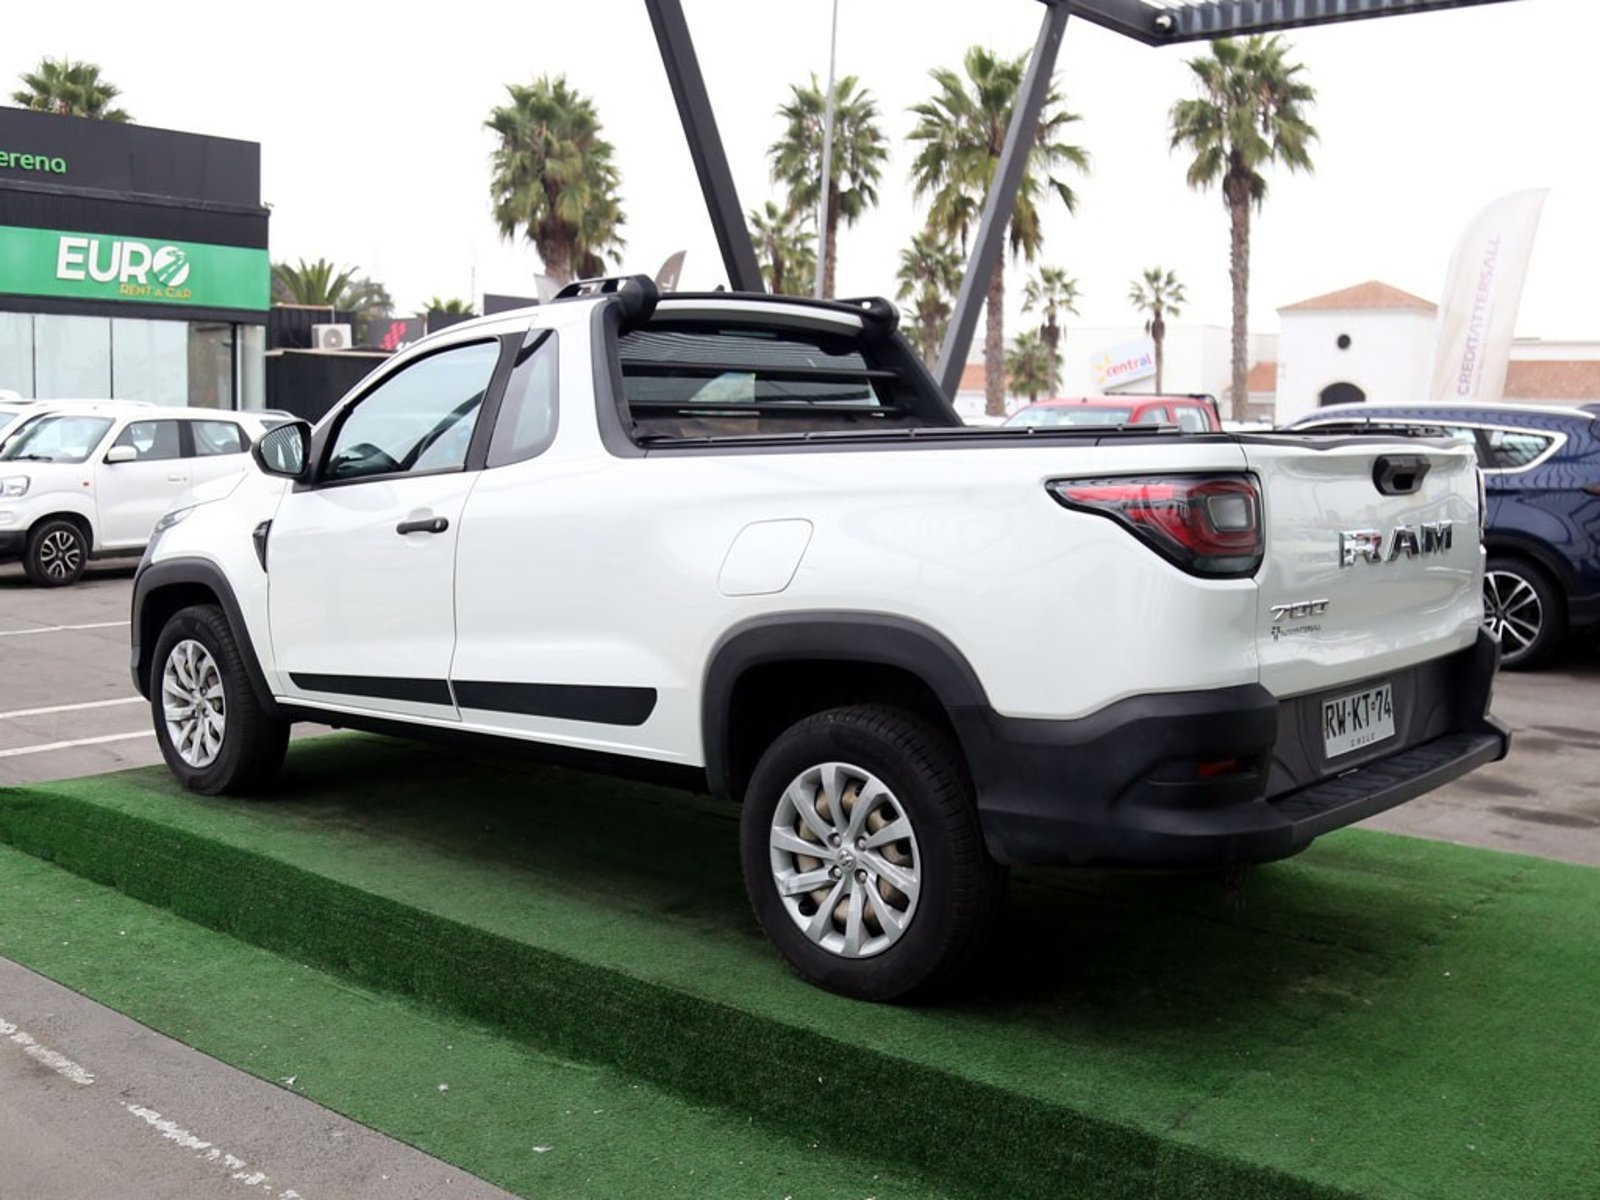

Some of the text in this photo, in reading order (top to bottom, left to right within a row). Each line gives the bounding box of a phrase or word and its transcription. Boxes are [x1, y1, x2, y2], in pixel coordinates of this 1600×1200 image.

[0, 150, 67, 174] erena
[56, 235, 190, 287] EURO
[1106, 352, 1152, 377] central
[1338, 519, 1453, 568] RAM
[1270, 598, 1329, 621] 700
